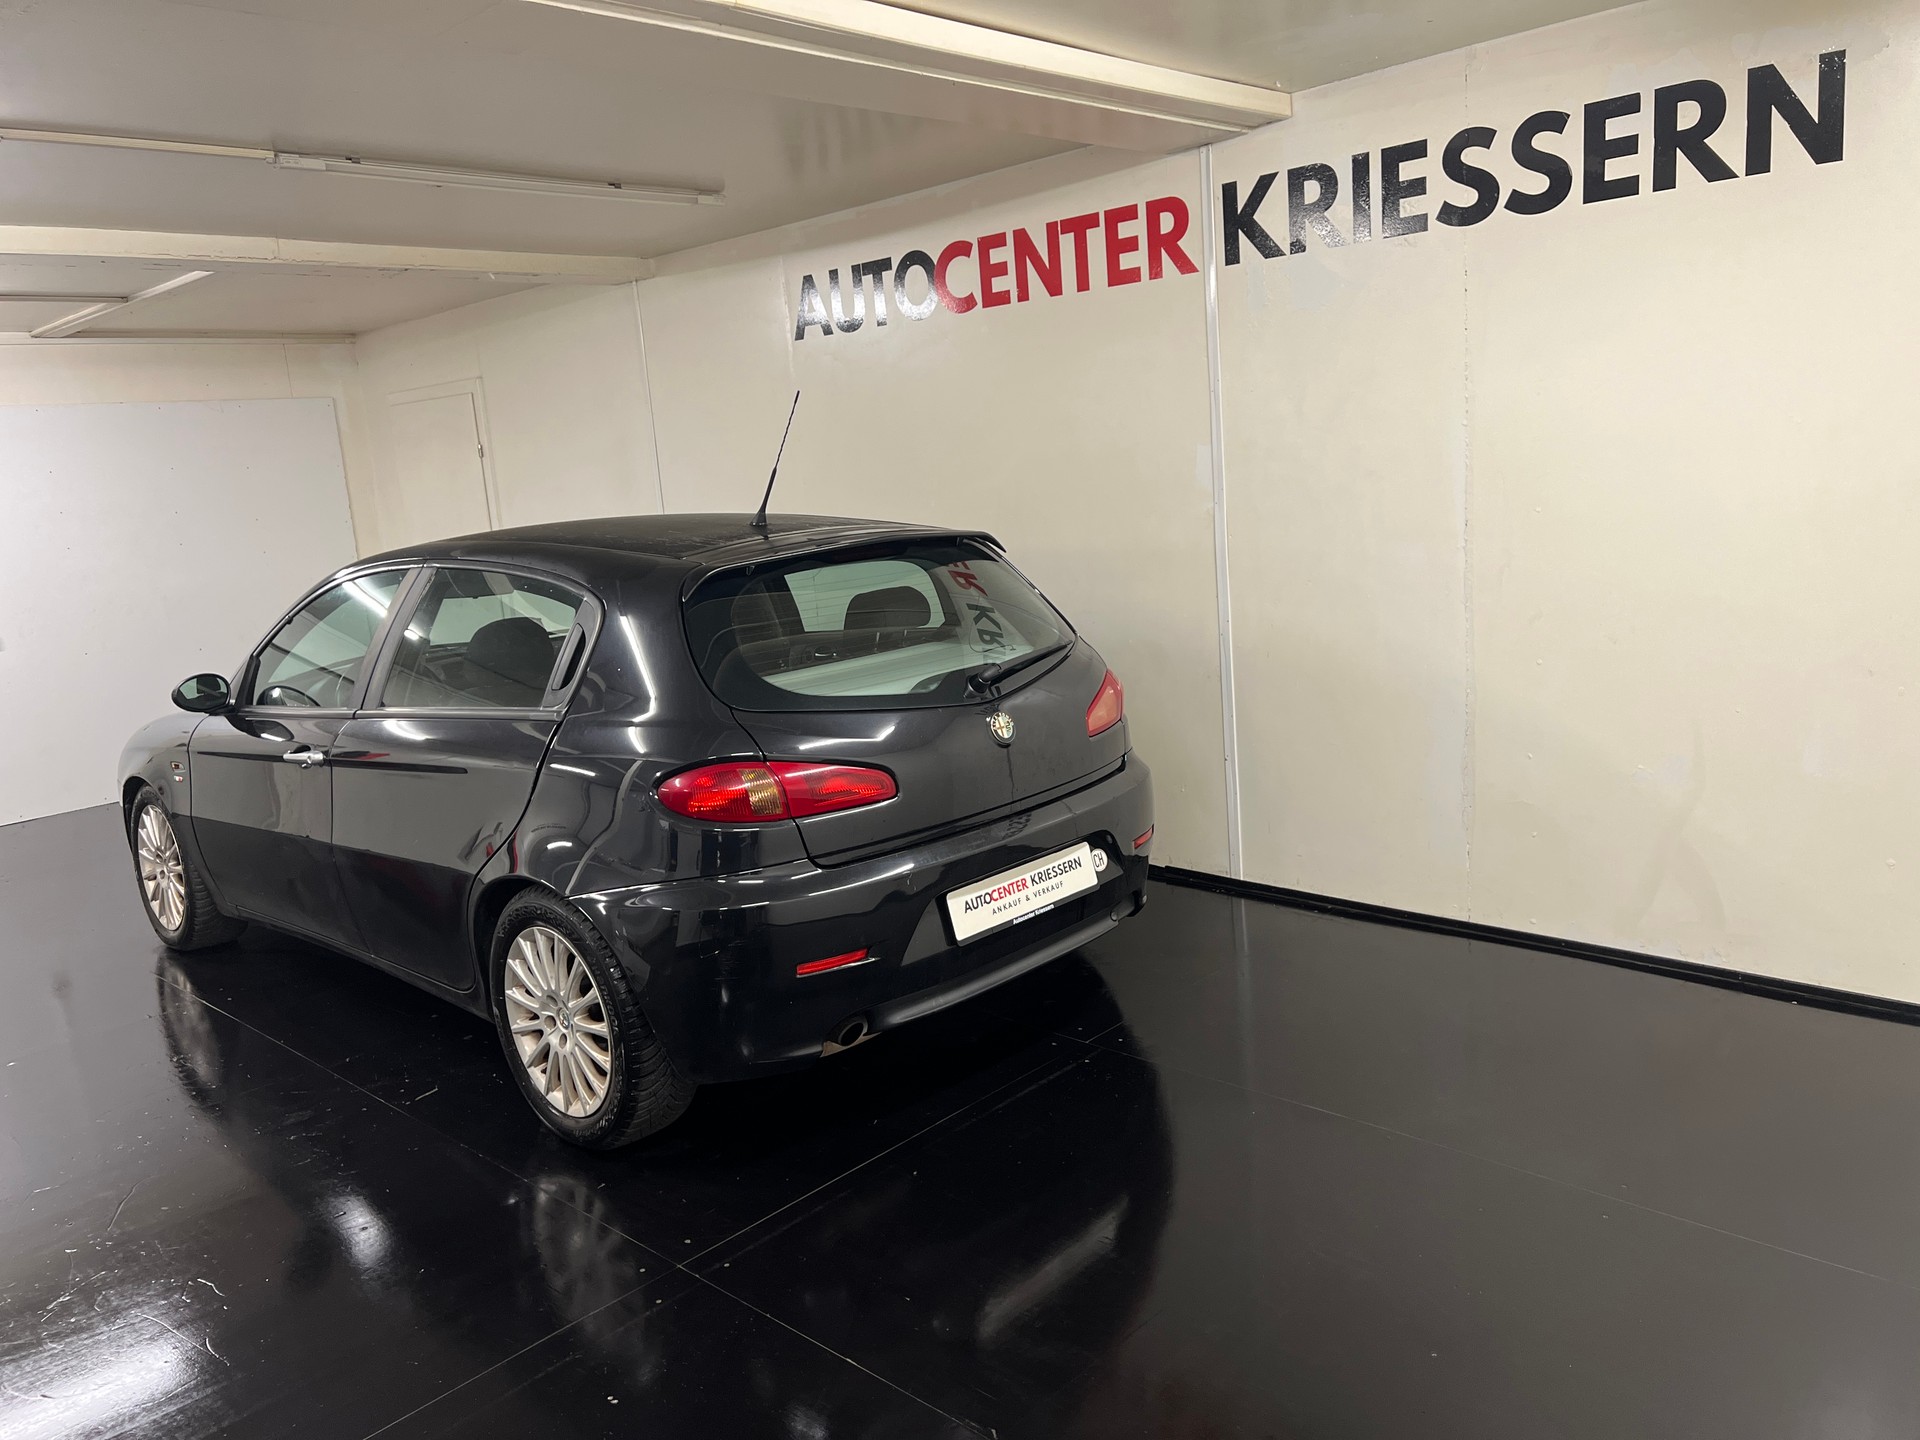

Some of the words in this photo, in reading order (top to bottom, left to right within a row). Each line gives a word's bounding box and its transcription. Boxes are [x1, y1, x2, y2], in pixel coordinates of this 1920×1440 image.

[794, 195, 1200, 341] AUTOCENTER
[1221, 48, 1847, 266] KRIESSERN
[1093, 851, 1105, 869] CH
[964, 877, 1029, 914] AUTOCENTER
[1030, 856, 1083, 887] KRIESSERN
[992, 897, 1022, 916] ANKAUF
[1033, 881, 1064, 898] VERKAUF
